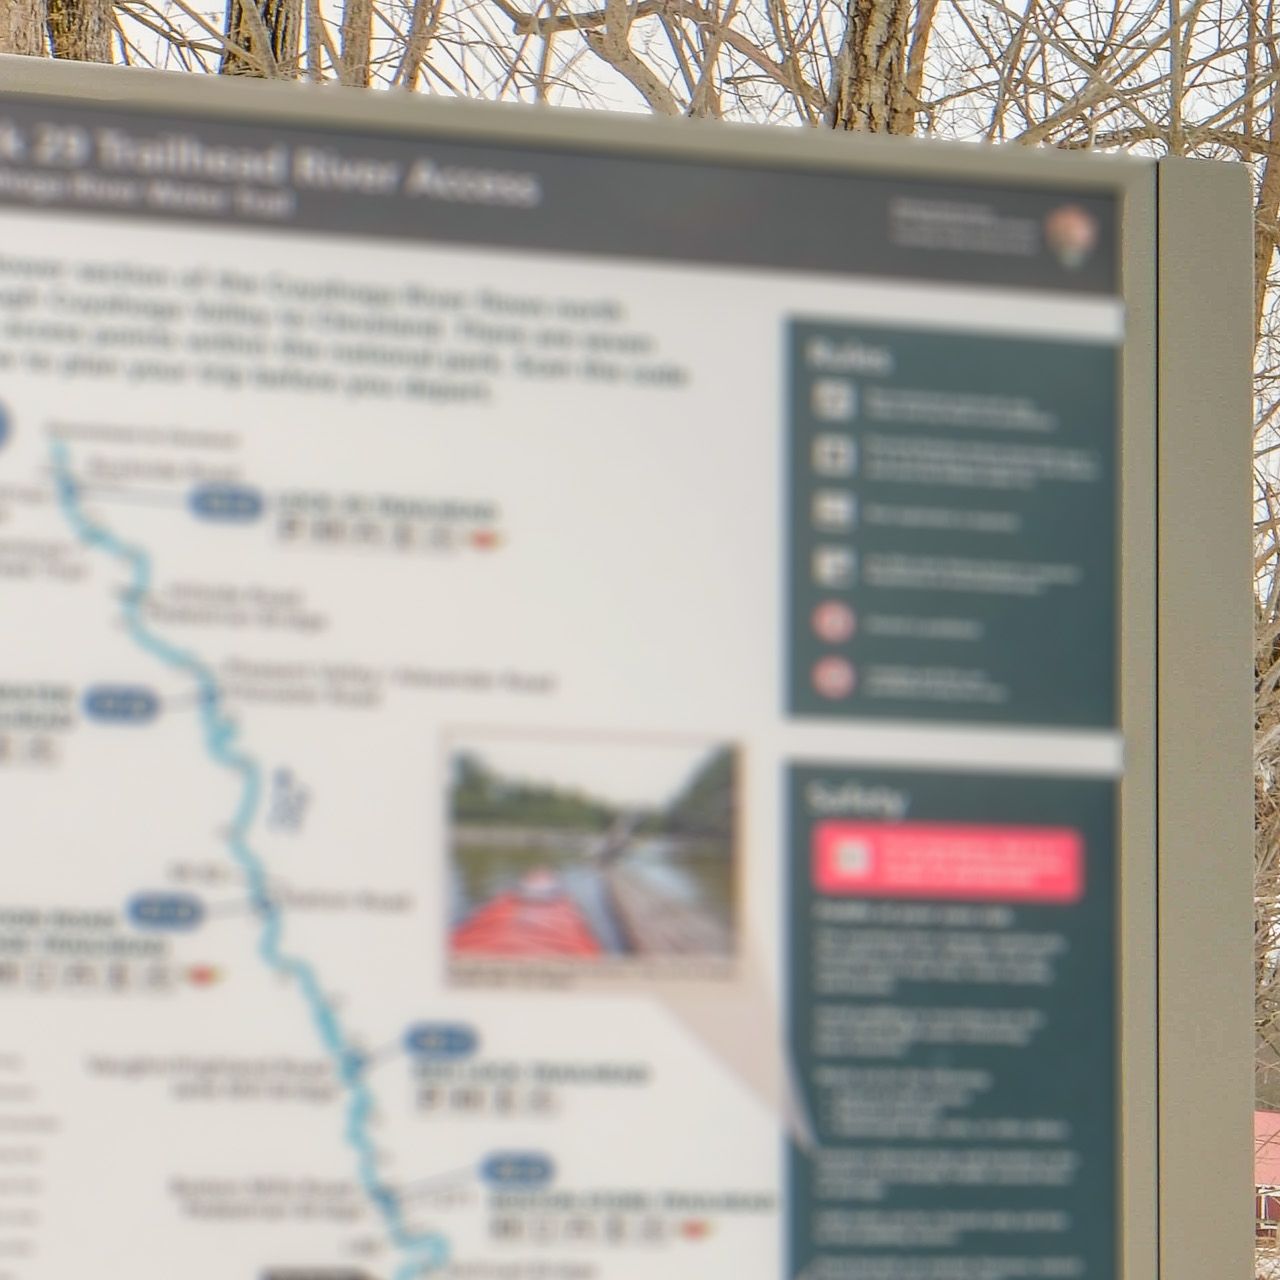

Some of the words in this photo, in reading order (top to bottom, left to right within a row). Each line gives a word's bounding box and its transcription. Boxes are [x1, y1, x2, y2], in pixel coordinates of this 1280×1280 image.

[35, 125, 88, 163] 29
[98, 131, 285, 183] Trailhead
[297, 148, 399, 191] River
[408, 161, 540, 204] Access
